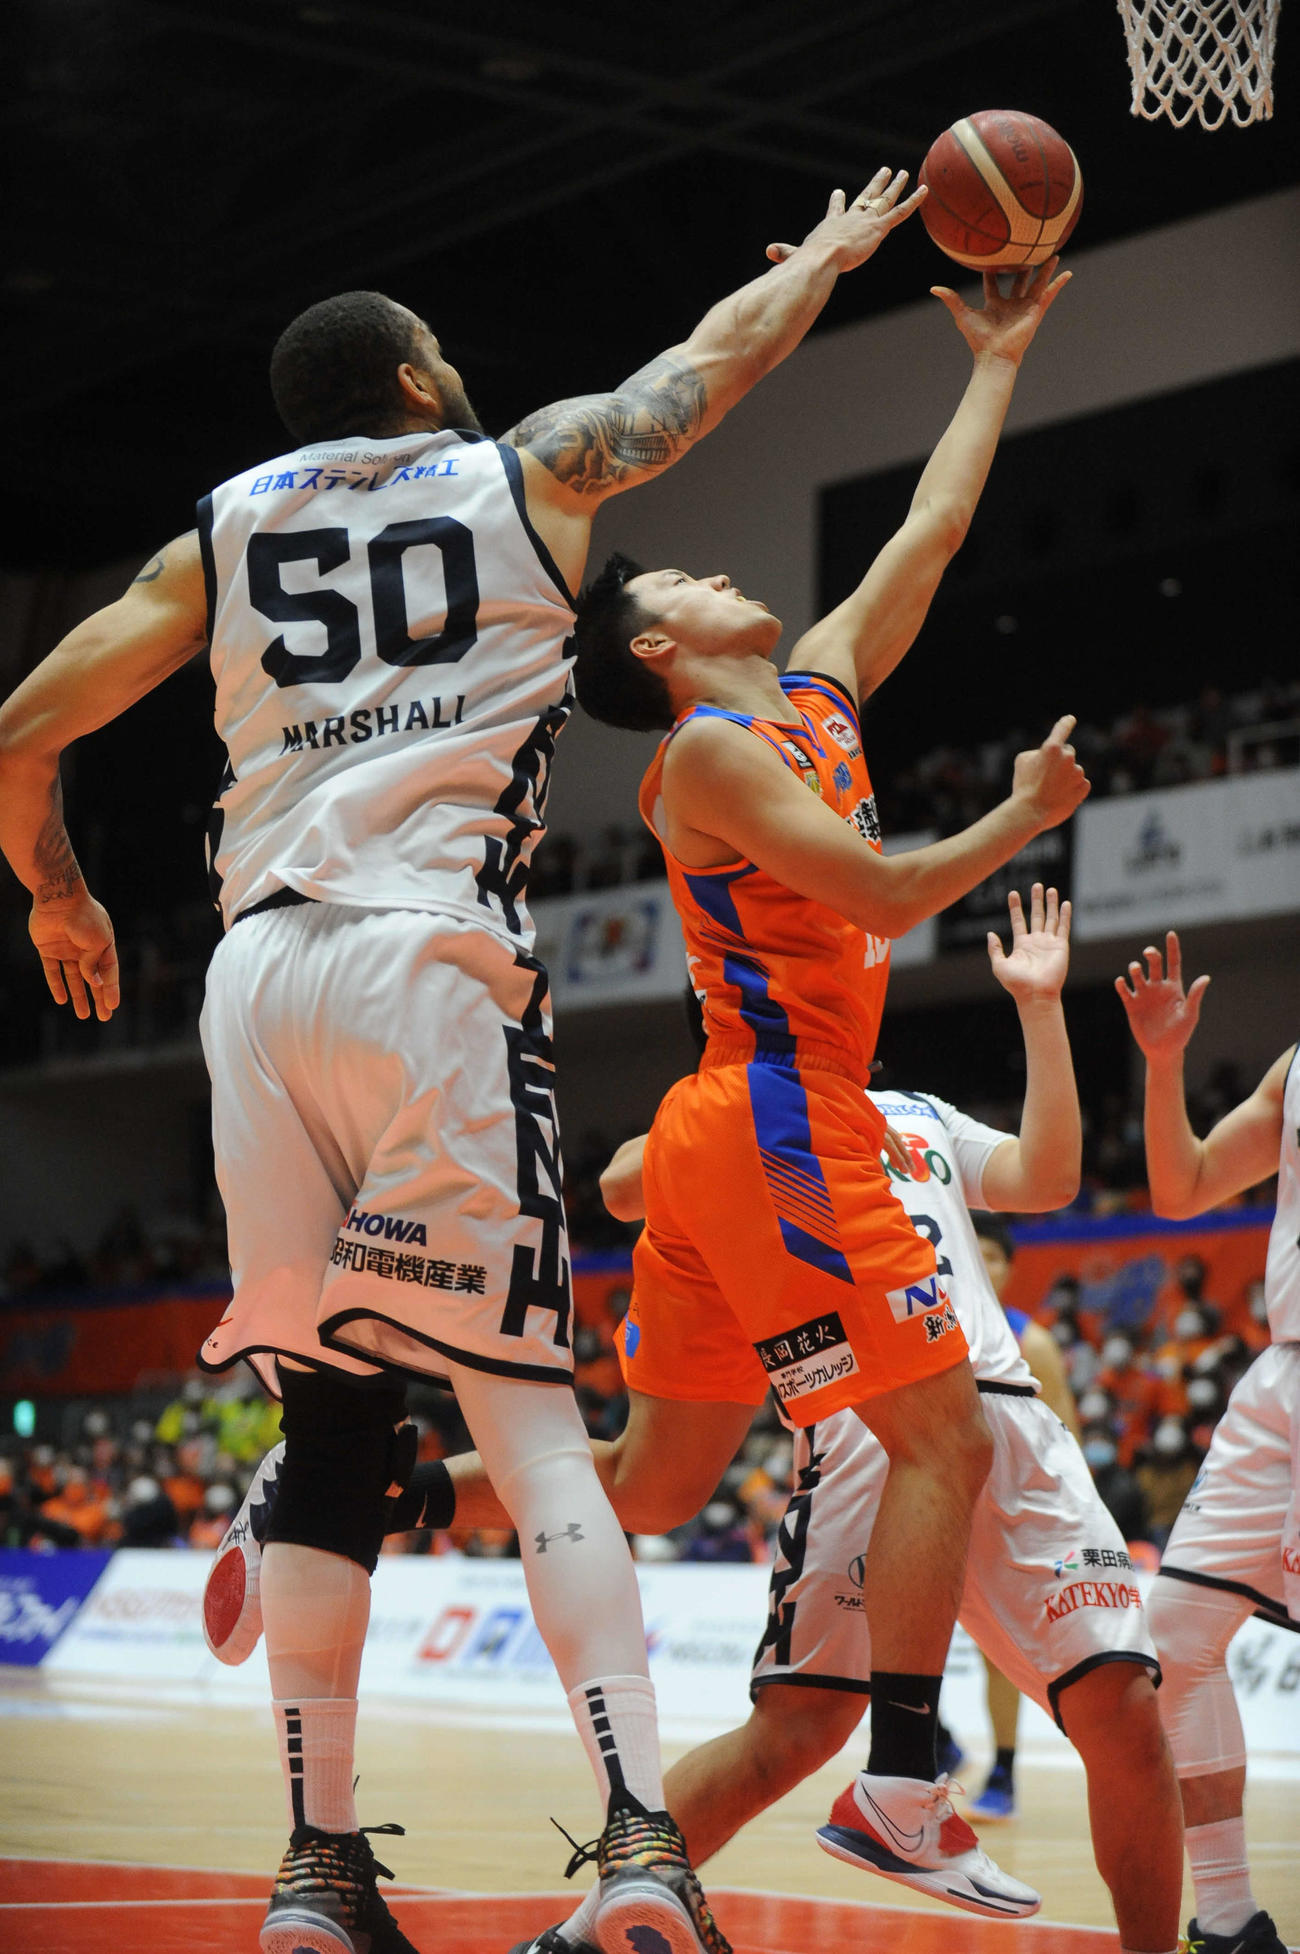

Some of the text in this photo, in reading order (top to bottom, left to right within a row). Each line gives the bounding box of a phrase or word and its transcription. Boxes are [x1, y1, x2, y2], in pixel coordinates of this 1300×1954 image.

[247, 515, 480, 688] 50
[279, 695, 466, 755] MARSHALL
[1081, 1548, 1136, 1571] 栗田病
